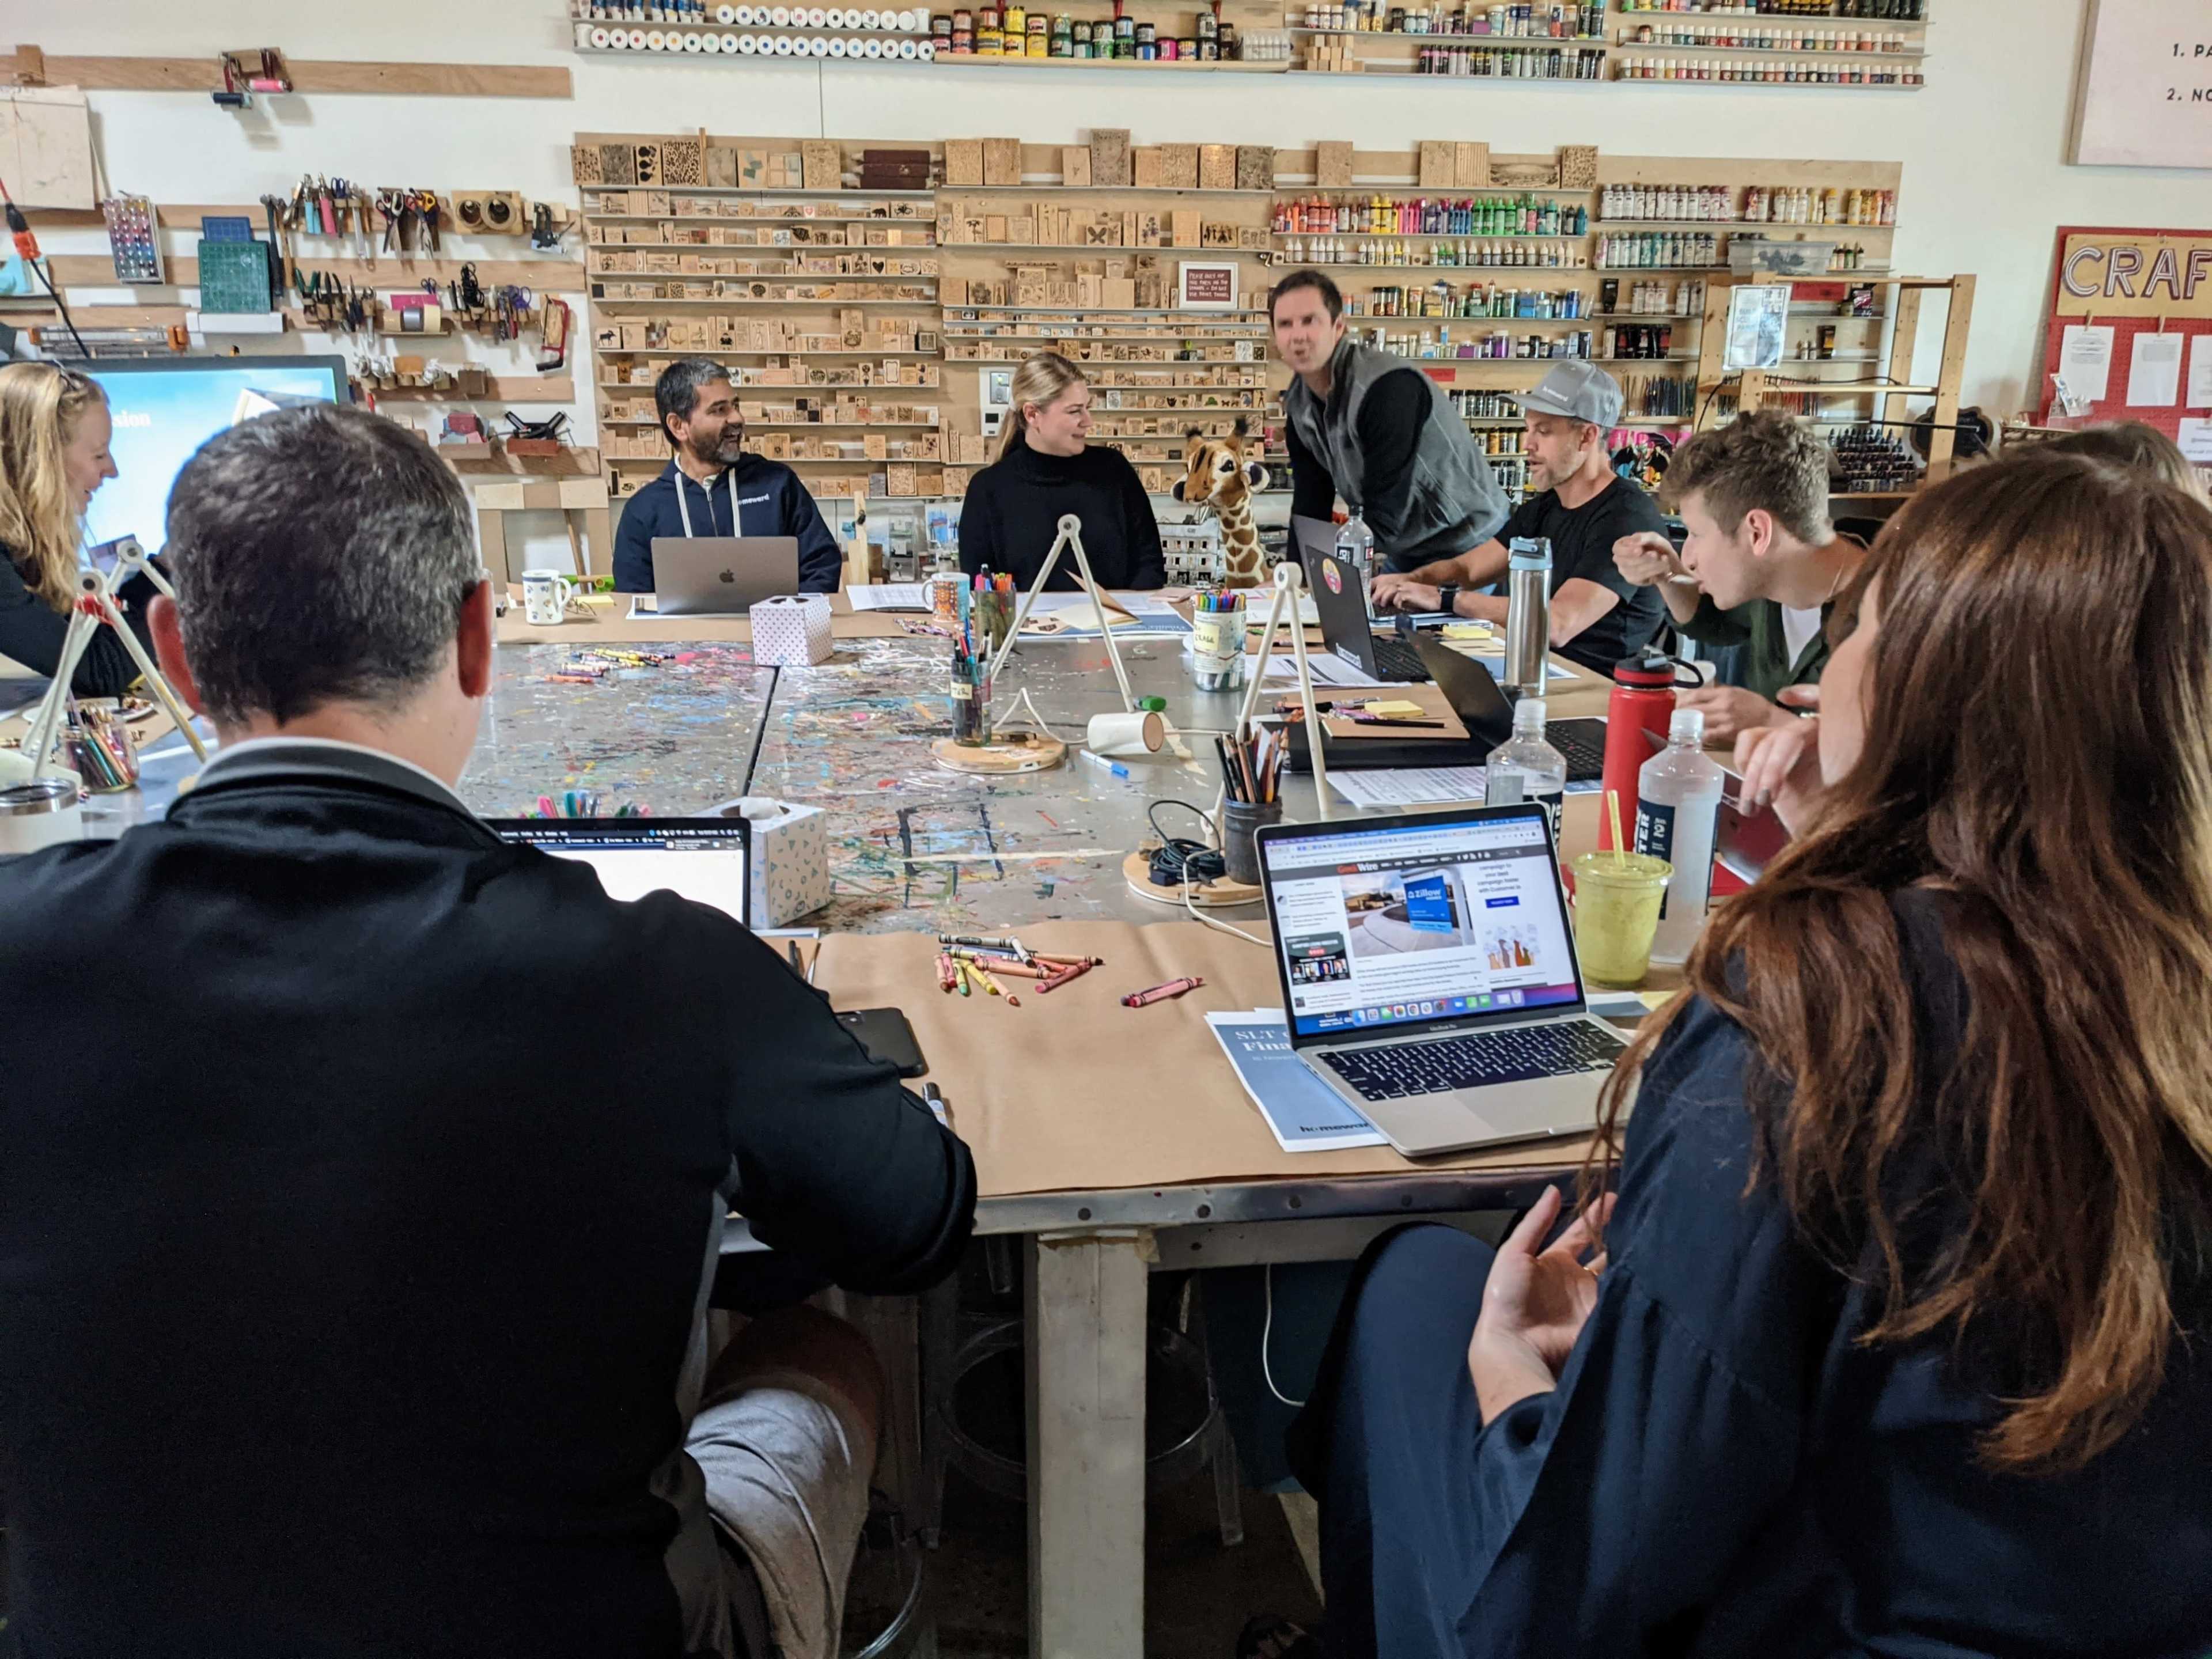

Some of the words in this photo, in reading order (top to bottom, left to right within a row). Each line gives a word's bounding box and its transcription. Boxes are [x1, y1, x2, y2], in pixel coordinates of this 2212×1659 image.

[2173, 43, 2185, 57] 1.
[2167, 88, 2182, 101] 2.
[738, 493, 770, 506] omeward
[1638, 813, 1650, 857] TER
[1414, 888, 1441, 898] Zillow
[1300, 1122, 1369, 1132] homewar
